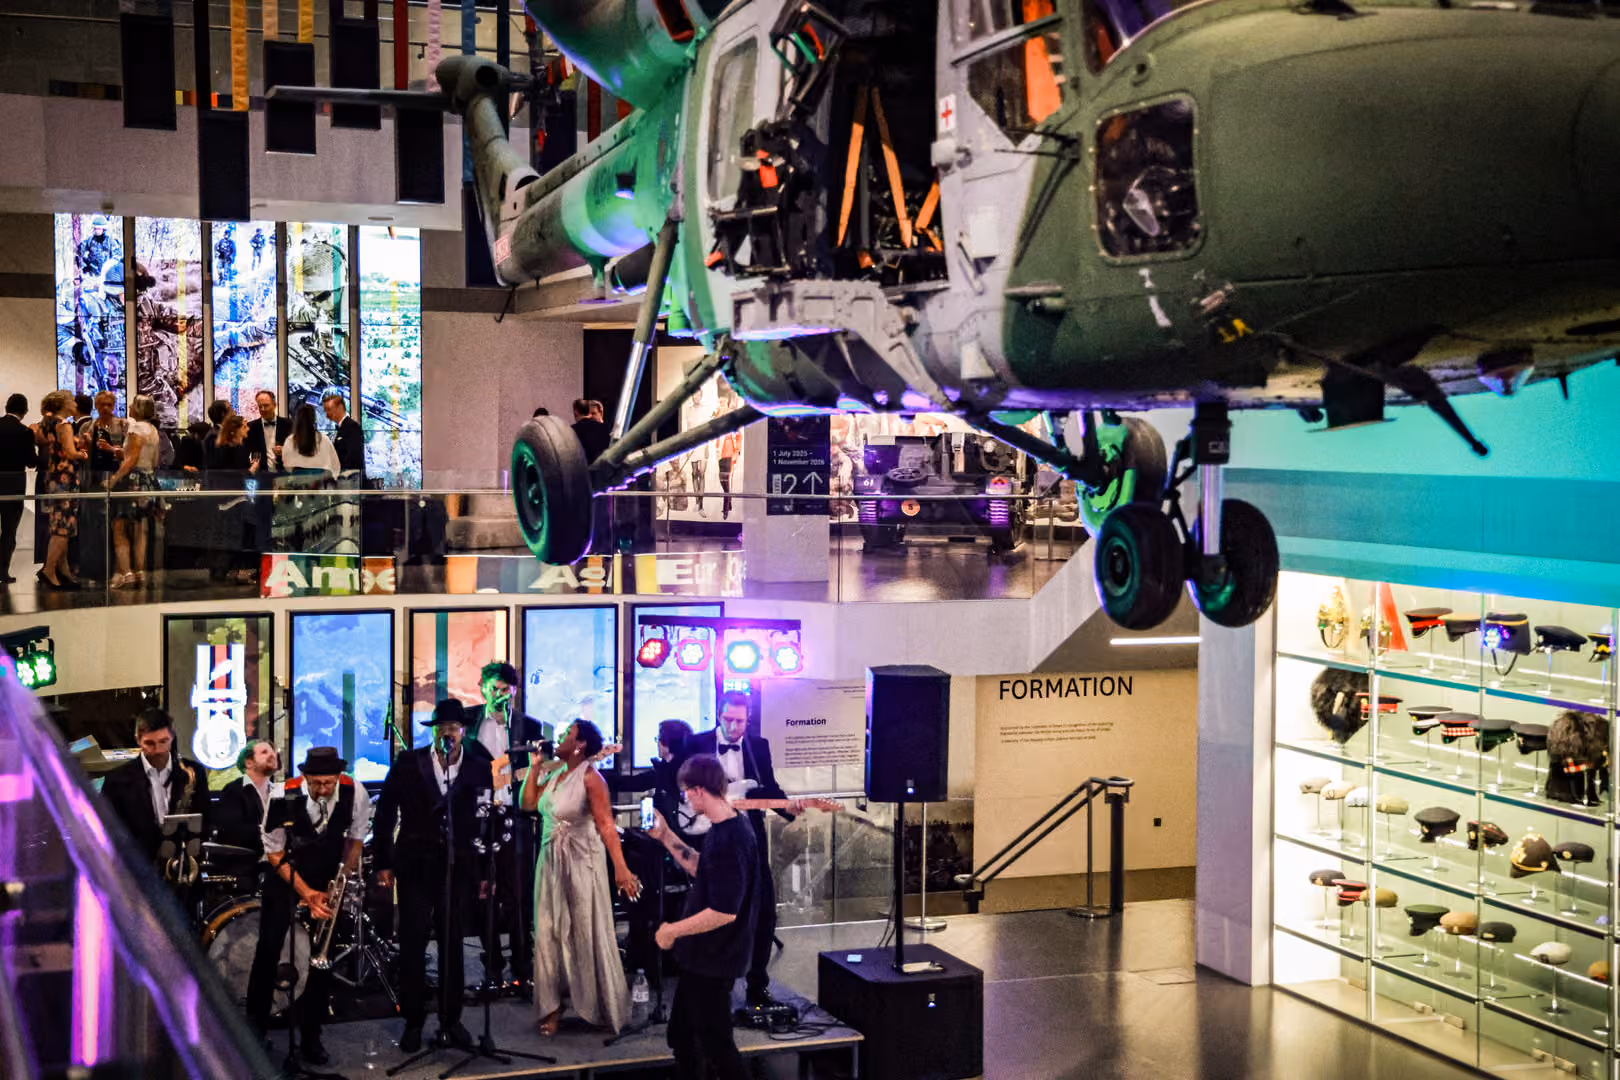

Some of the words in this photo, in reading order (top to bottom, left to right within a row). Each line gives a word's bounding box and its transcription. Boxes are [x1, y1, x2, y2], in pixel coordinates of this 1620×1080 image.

[783, 473, 798, 495] 2
[999, 675, 1133, 700] FORMATION
[786, 716, 827, 726] Formation
